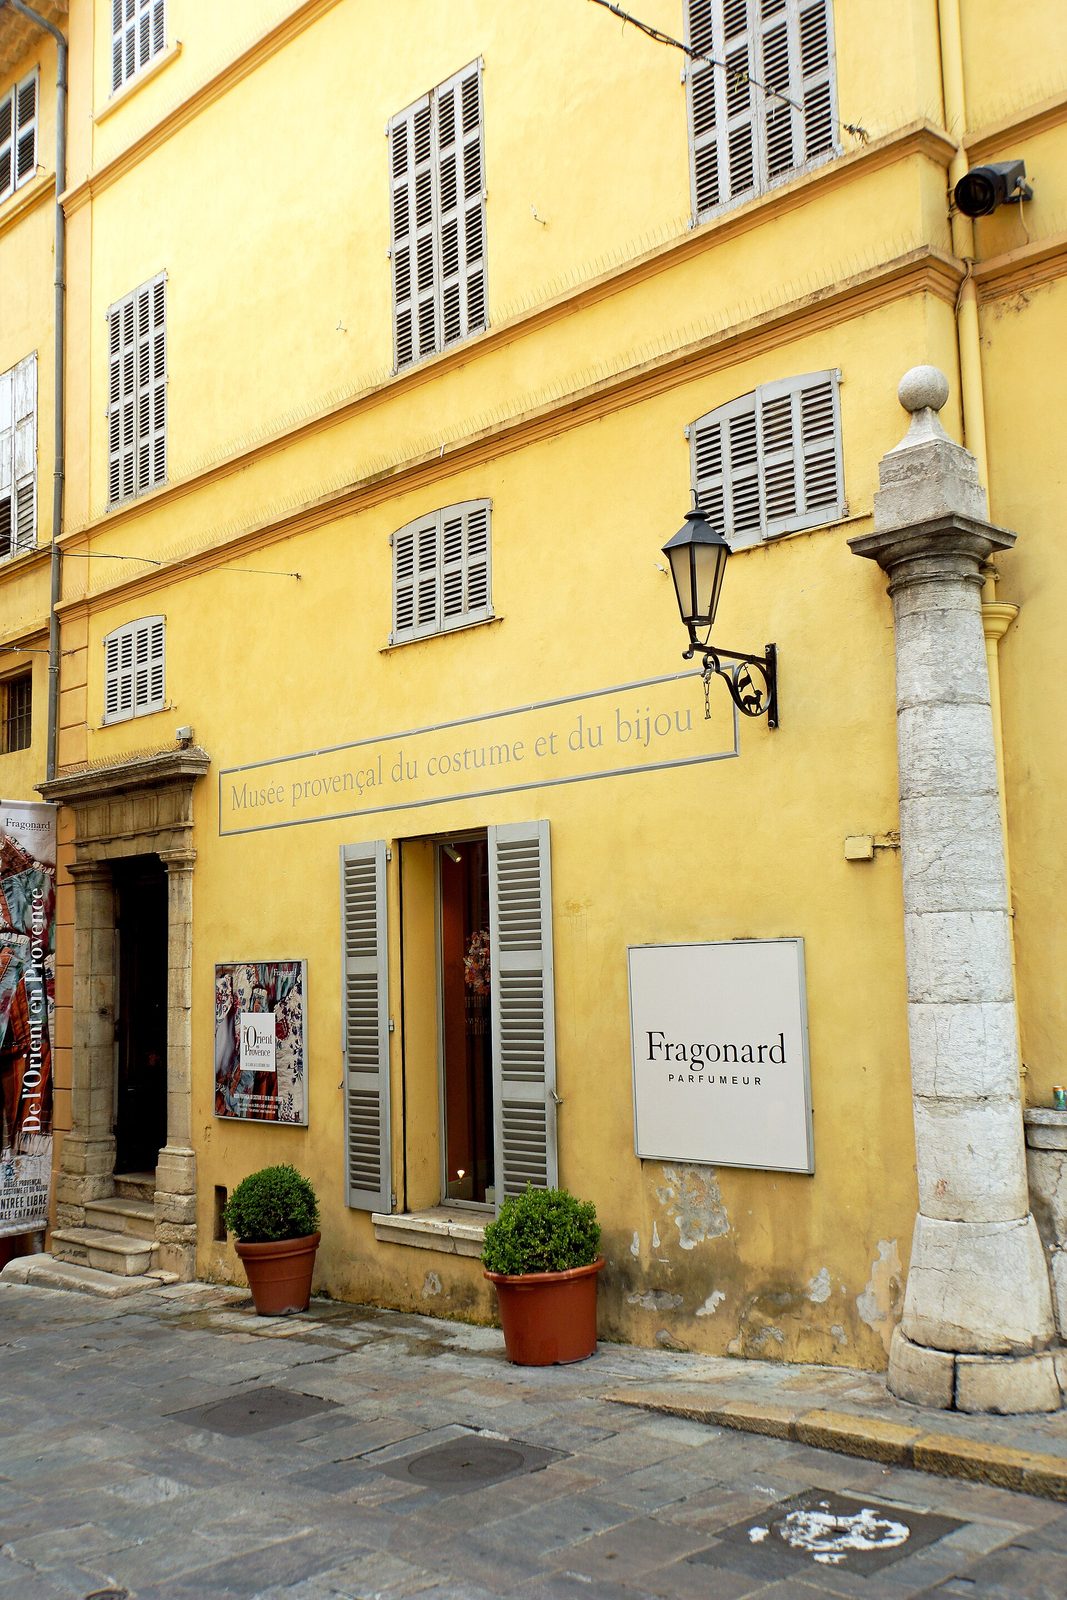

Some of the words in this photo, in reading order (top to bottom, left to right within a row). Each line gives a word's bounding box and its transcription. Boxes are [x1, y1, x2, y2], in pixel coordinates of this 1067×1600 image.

[231, 780, 285, 811] Musée
[292, 754, 383, 807] provençal
[391, 751, 418, 783] du
[427, 741, 525, 777] costume
[534, 731, 559, 757] et
[568, 714, 604, 751] du
[615, 706, 693, 747] bijou
[5, 817, 51, 830] Fragonard
[25, 888, 44, 982] Provence
[31, 988, 43, 1014] en
[22, 1020, 42, 1099] l'Orient
[646, 1031, 787, 1072] Fragonard
[668, 1074, 761, 1086] PARFUMEUR
[22, 1103, 41, 1132] De
[0, 1194, 24, 1210] NTRÉE
[27, 1194, 47, 1207] LIBRE
[0, 1210, 12, 1220] REE
[14, 1206, 46, 1219] ENTRANCE
